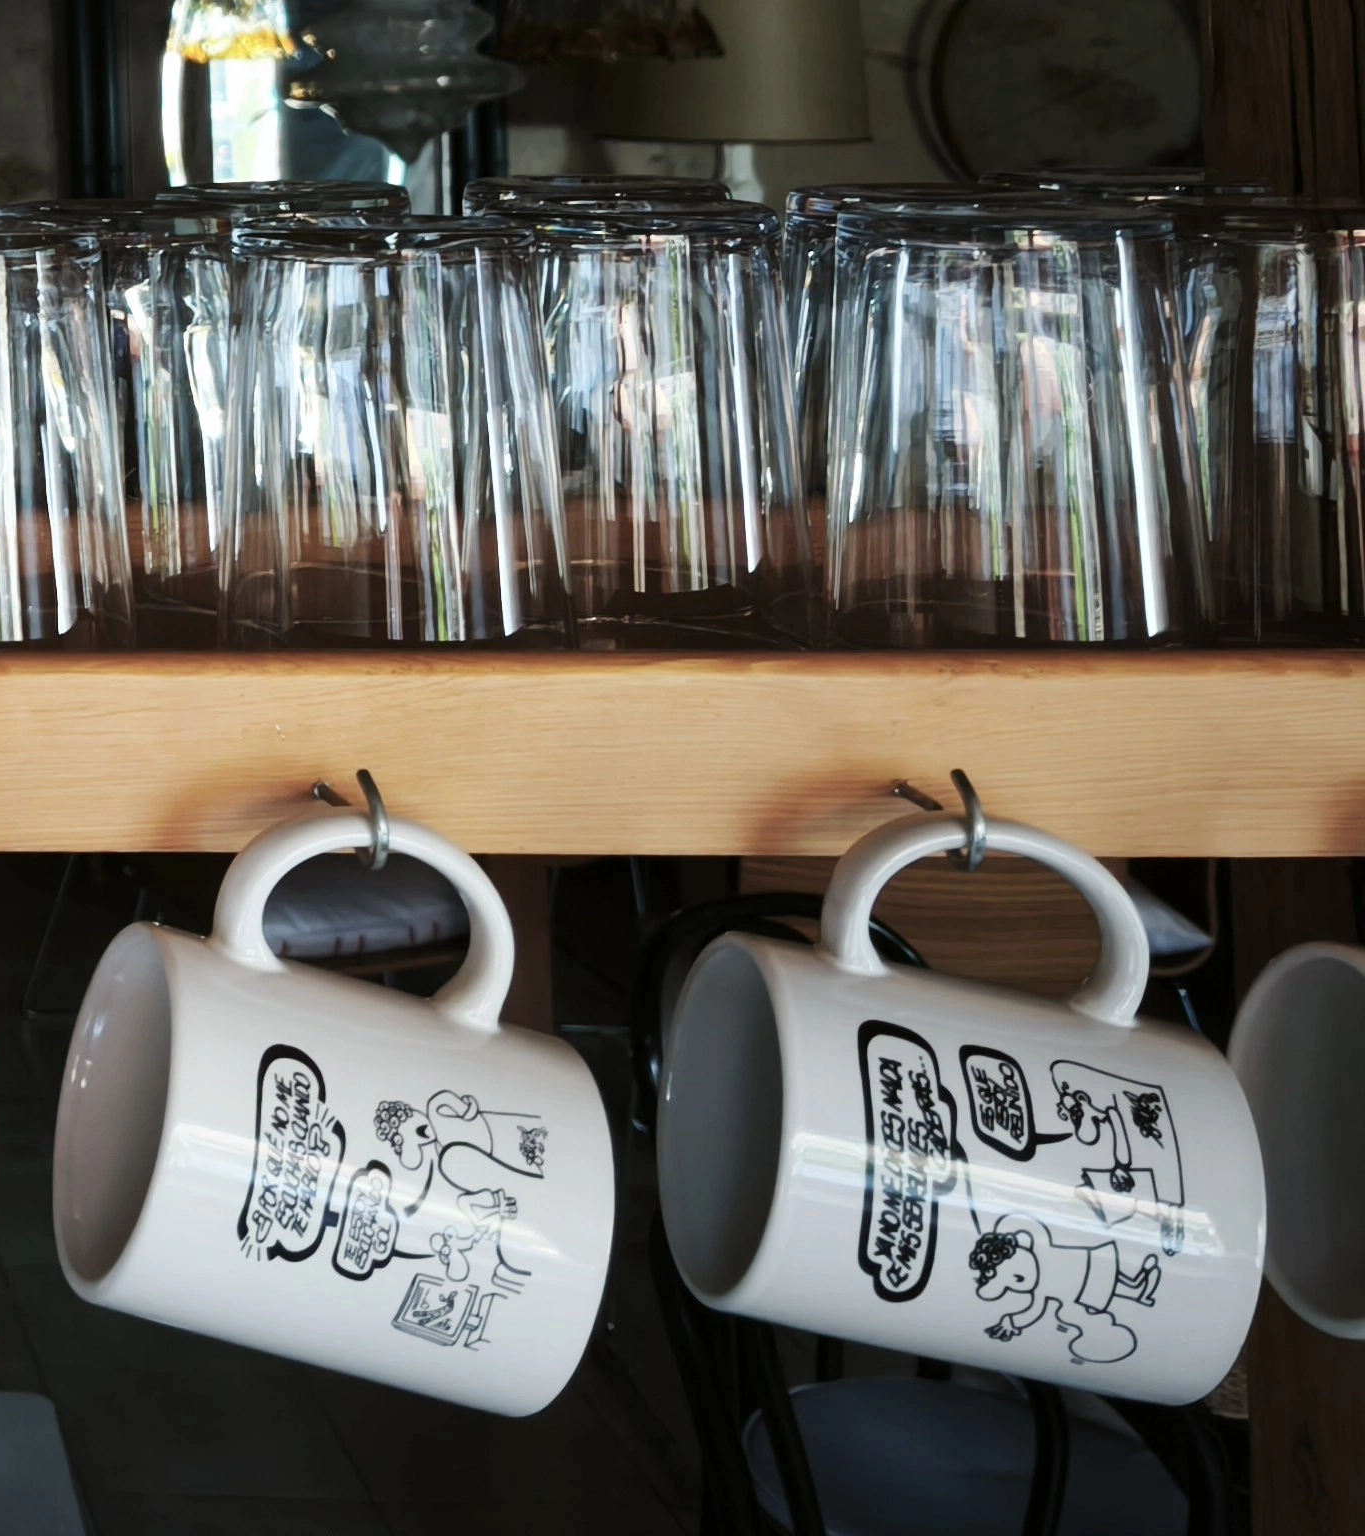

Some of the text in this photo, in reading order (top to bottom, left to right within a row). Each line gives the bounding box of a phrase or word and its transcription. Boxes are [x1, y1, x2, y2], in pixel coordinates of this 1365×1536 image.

[274, 1073, 292, 1108] ME
[878, 1057, 903, 1113] NADA
[970, 1065, 995, 1131] ES QUE
[988, 1078, 1009, 1130] ESTOY
[998, 1062, 1025, 1144] REUNIDO
[271, 1107, 289, 1133] NO
[264, 1132, 284, 1176] QUÉ
[274, 1072, 311, 1230] ESCUCHAS CUANDO
[290, 1123, 330, 1238] TE HABLO?
[881, 1175, 902, 1212] ME
[343, 1188, 366, 1260] TE ESTOY
[354, 1178, 383, 1270] ESCUCHANDO
[373, 1223, 391, 1254] GOL
[878, 1210, 901, 1240] NO
[874, 1236, 895, 1262] YA
[896, 1230, 921, 1270] MIS
[886, 1262, 909, 1288] DE
